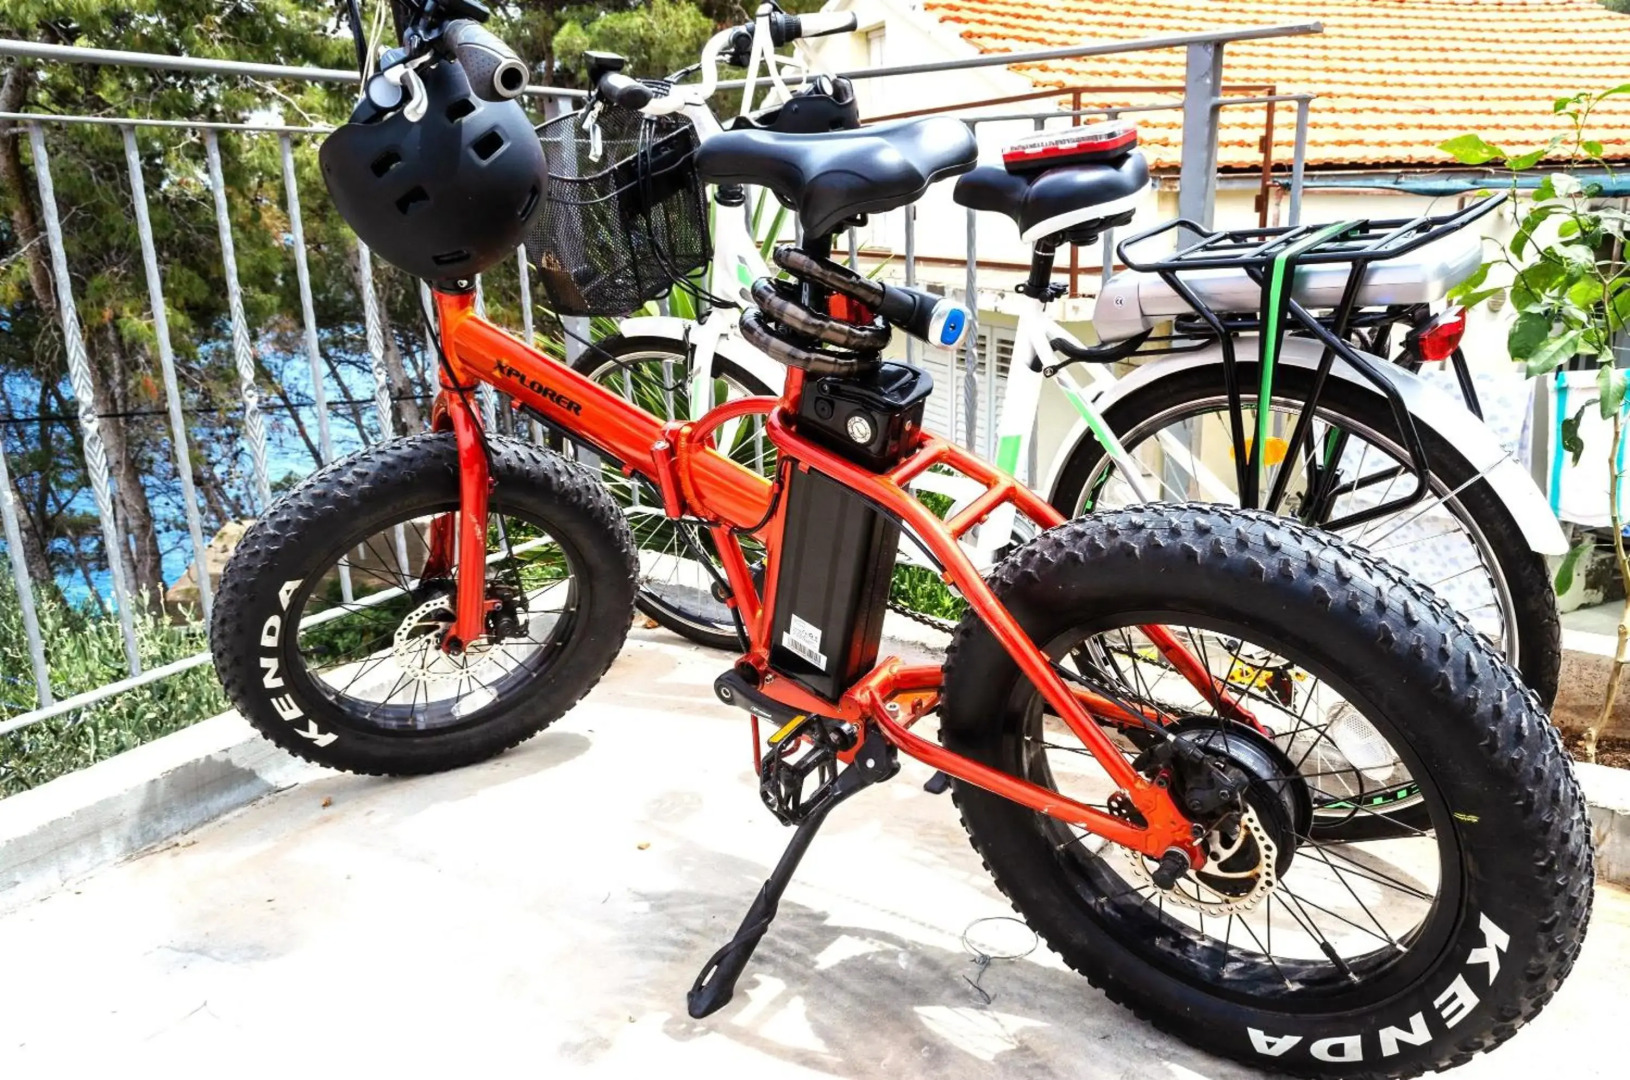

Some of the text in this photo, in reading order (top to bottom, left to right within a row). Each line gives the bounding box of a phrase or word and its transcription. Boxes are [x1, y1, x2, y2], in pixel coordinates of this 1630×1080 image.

[493, 359, 582, 416] XPLORER
[260, 579, 339, 747] KENDA
[1247, 912, 1510, 1062] KENDA
